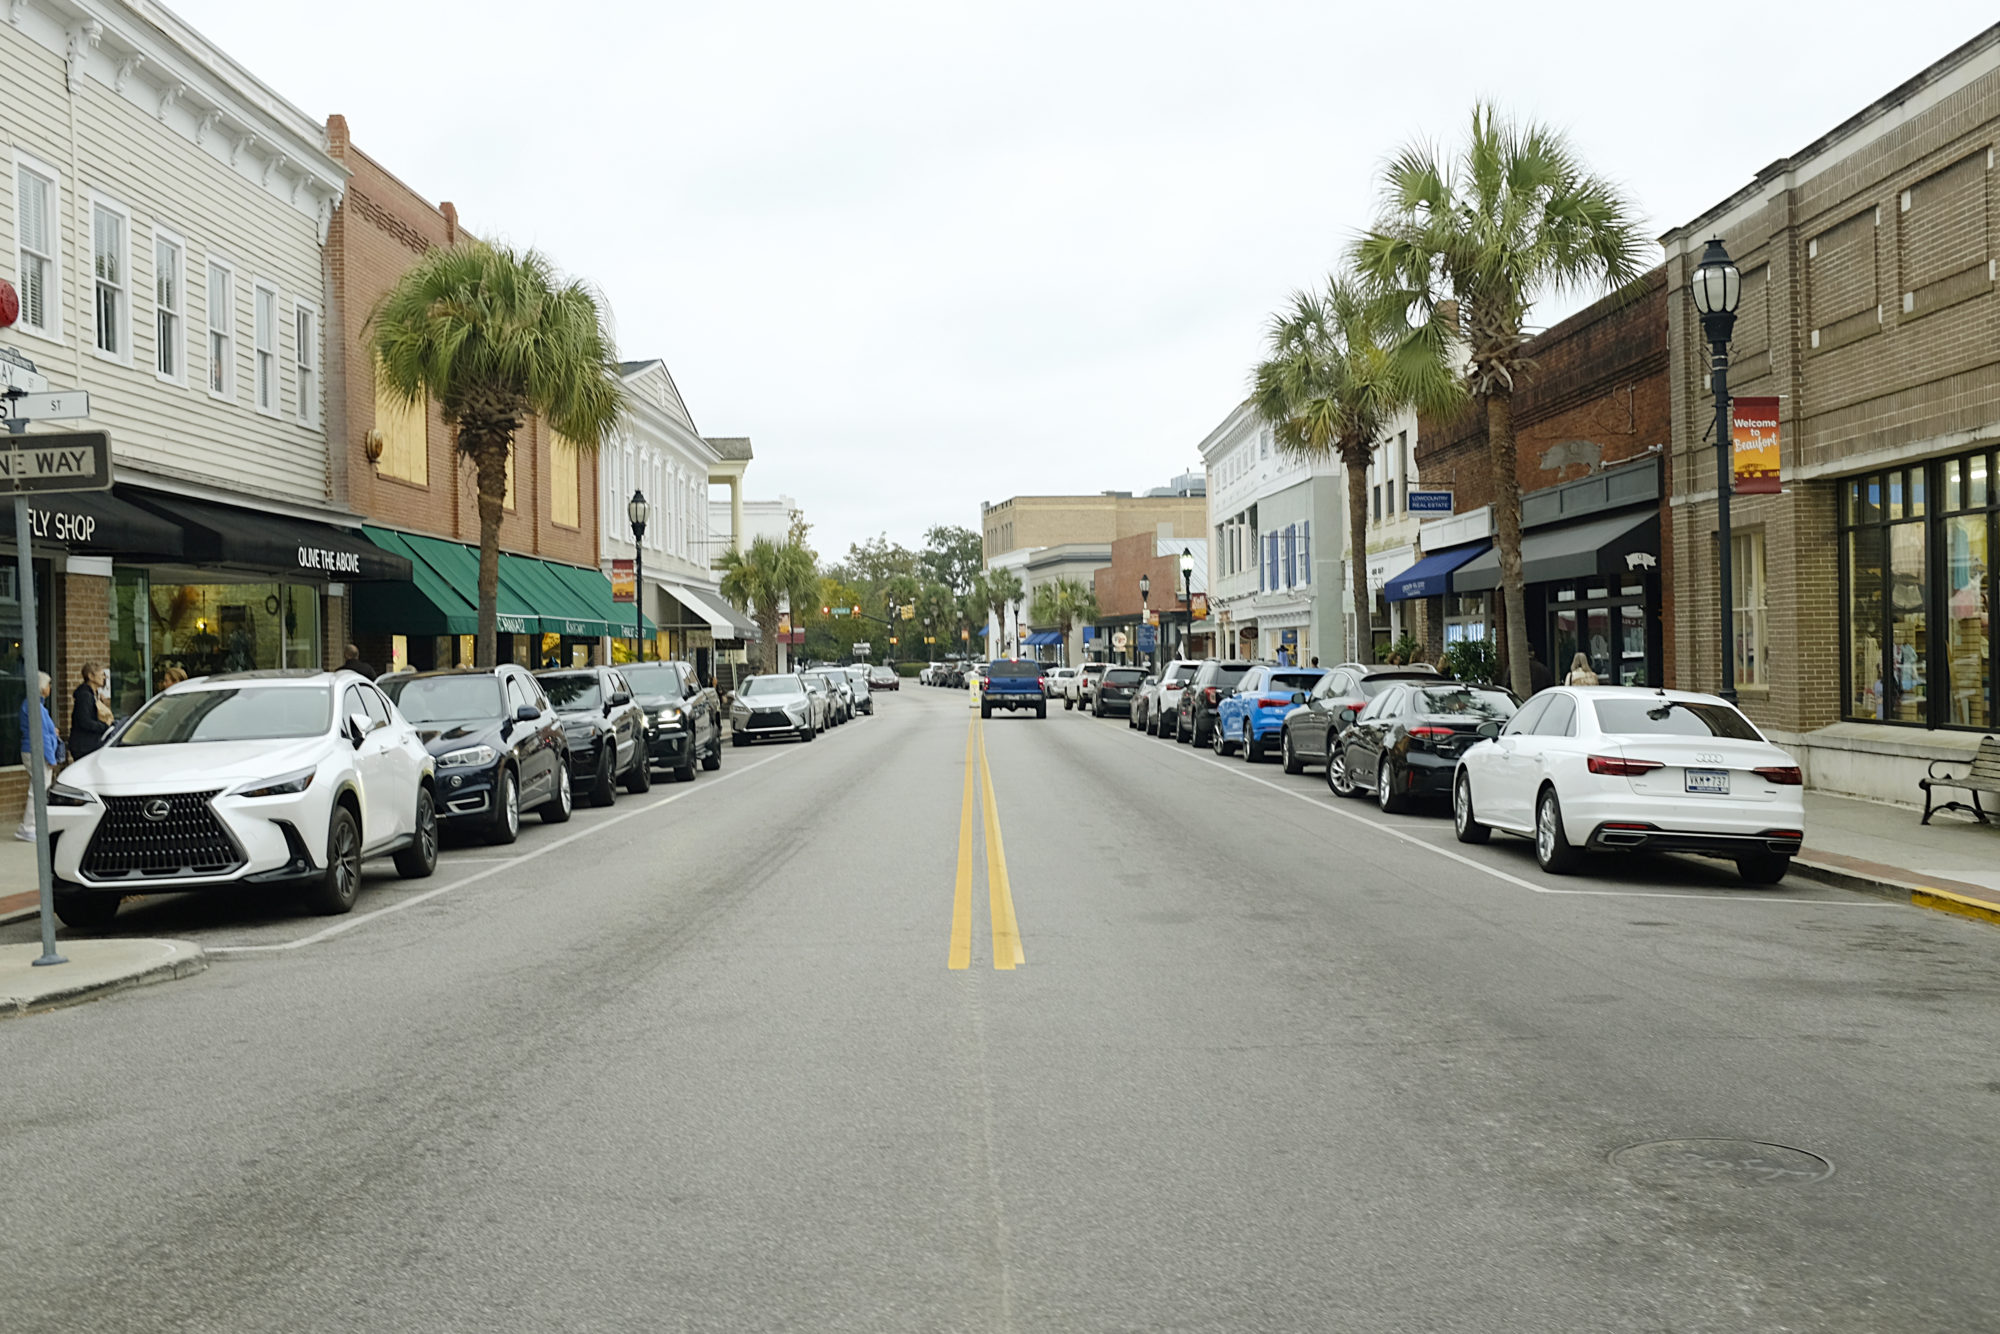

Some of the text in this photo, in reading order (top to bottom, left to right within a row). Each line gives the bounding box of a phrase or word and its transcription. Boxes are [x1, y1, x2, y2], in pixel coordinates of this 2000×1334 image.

[51, 400, 62, 412] ST
[1734, 419, 1777, 428] Welcome
[1750, 428, 1761, 437] to
[1734, 432, 1777, 453] Beaufort
[35, 450, 86, 474] WAY
[55, 512, 96, 541] SHOP
[298, 546, 360, 574] OLIVE THE ABOVE
[1712, 776, 1727, 787] 737
